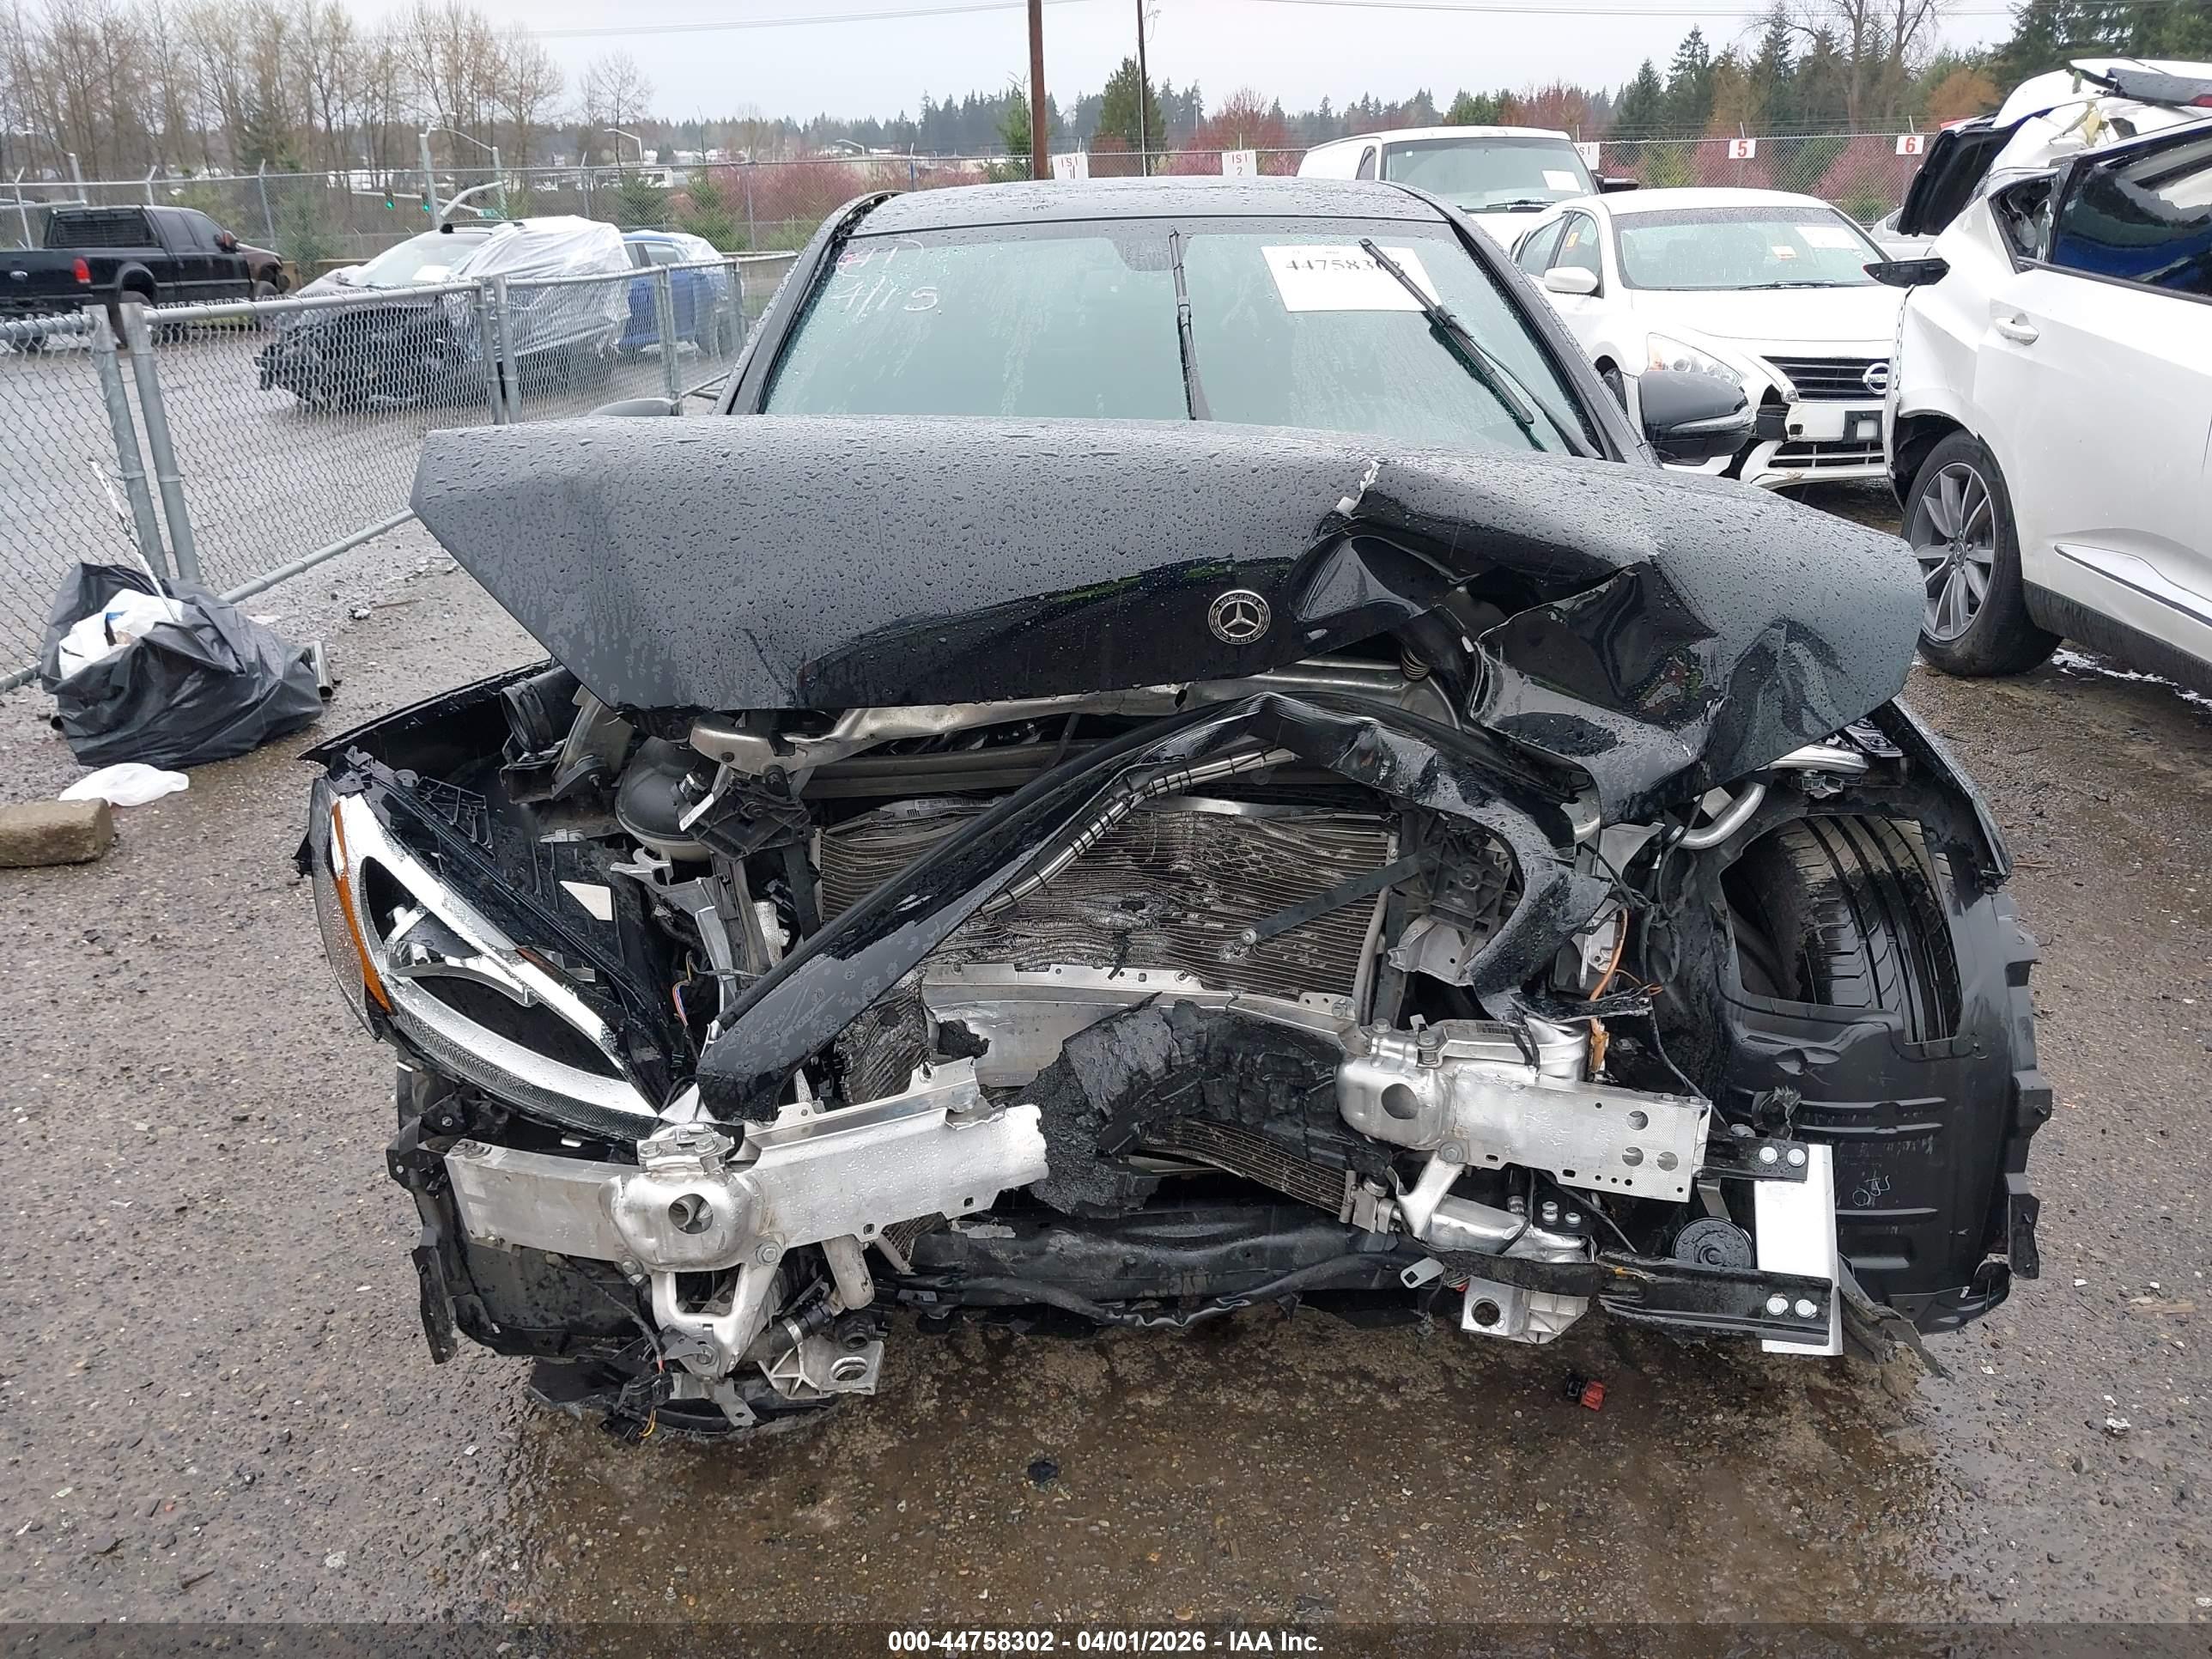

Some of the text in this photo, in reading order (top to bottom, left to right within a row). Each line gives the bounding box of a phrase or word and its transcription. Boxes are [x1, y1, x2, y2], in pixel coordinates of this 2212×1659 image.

[1737, 140, 1747, 157] 5
[1905, 137, 1916, 153] 6
[1237, 166, 1243, 177] 2
[1218, 593, 1259, 607] MERCEDES
